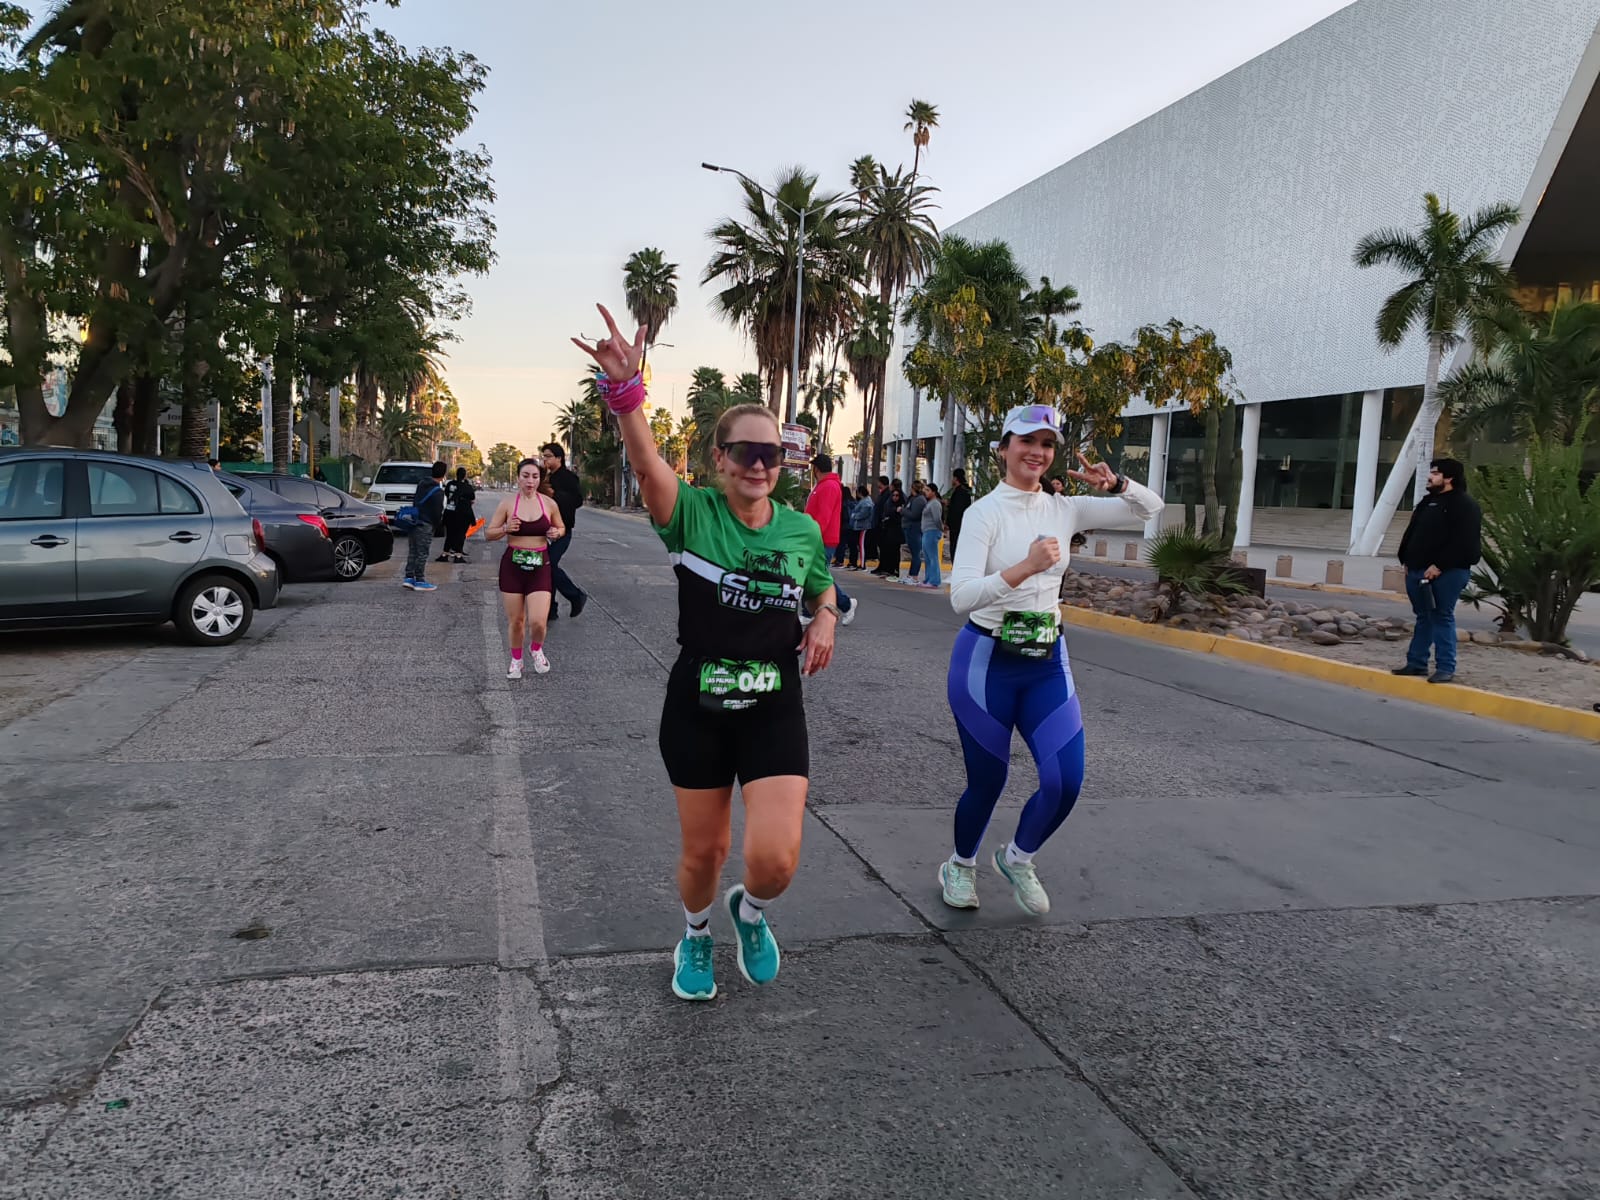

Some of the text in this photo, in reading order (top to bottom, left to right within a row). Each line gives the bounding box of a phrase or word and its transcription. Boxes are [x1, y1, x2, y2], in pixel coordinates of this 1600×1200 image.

[721, 590, 798, 611] vitu 2026
[738, 672, 776, 692] 047
